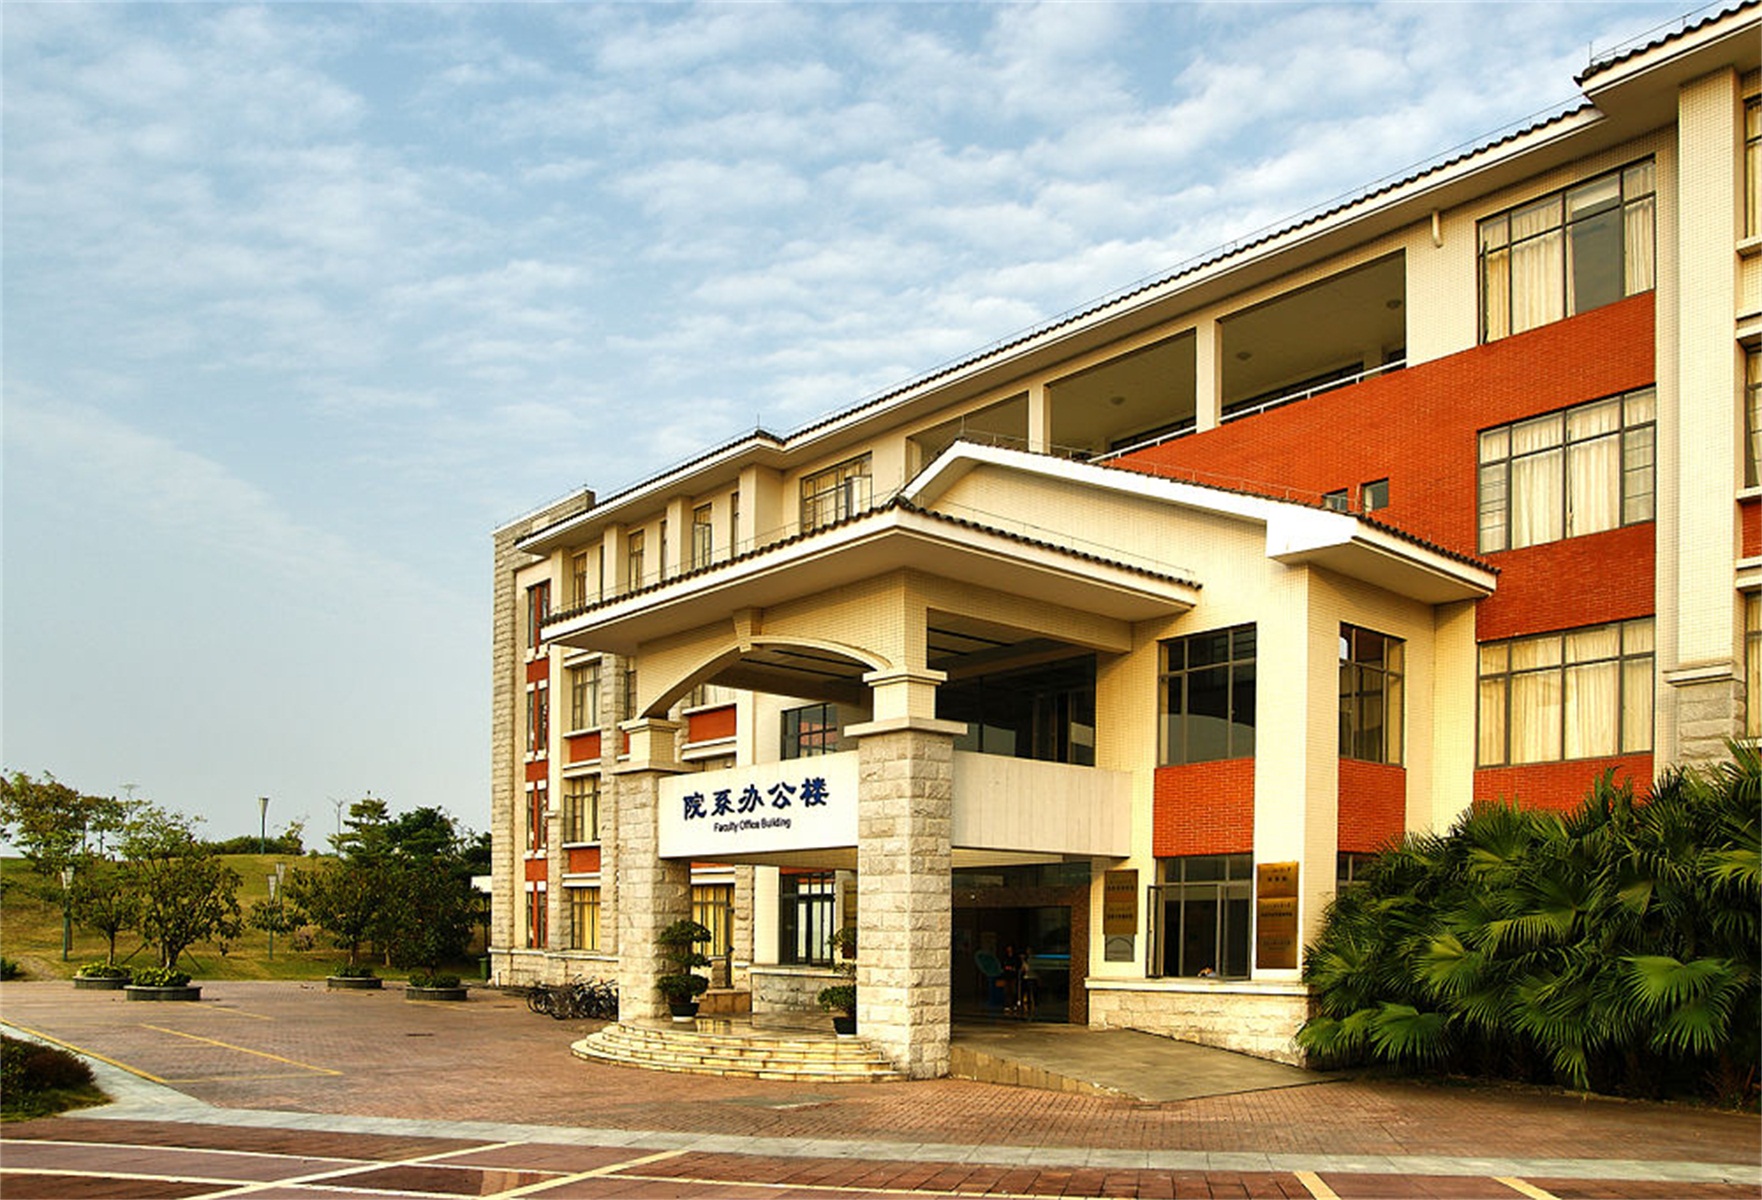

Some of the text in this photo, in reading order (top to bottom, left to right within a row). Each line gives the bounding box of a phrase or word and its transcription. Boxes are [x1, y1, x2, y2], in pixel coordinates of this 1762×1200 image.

[683, 776, 830, 821] 院系办公楼
[713, 817, 791, 833] Faculty Office Building
